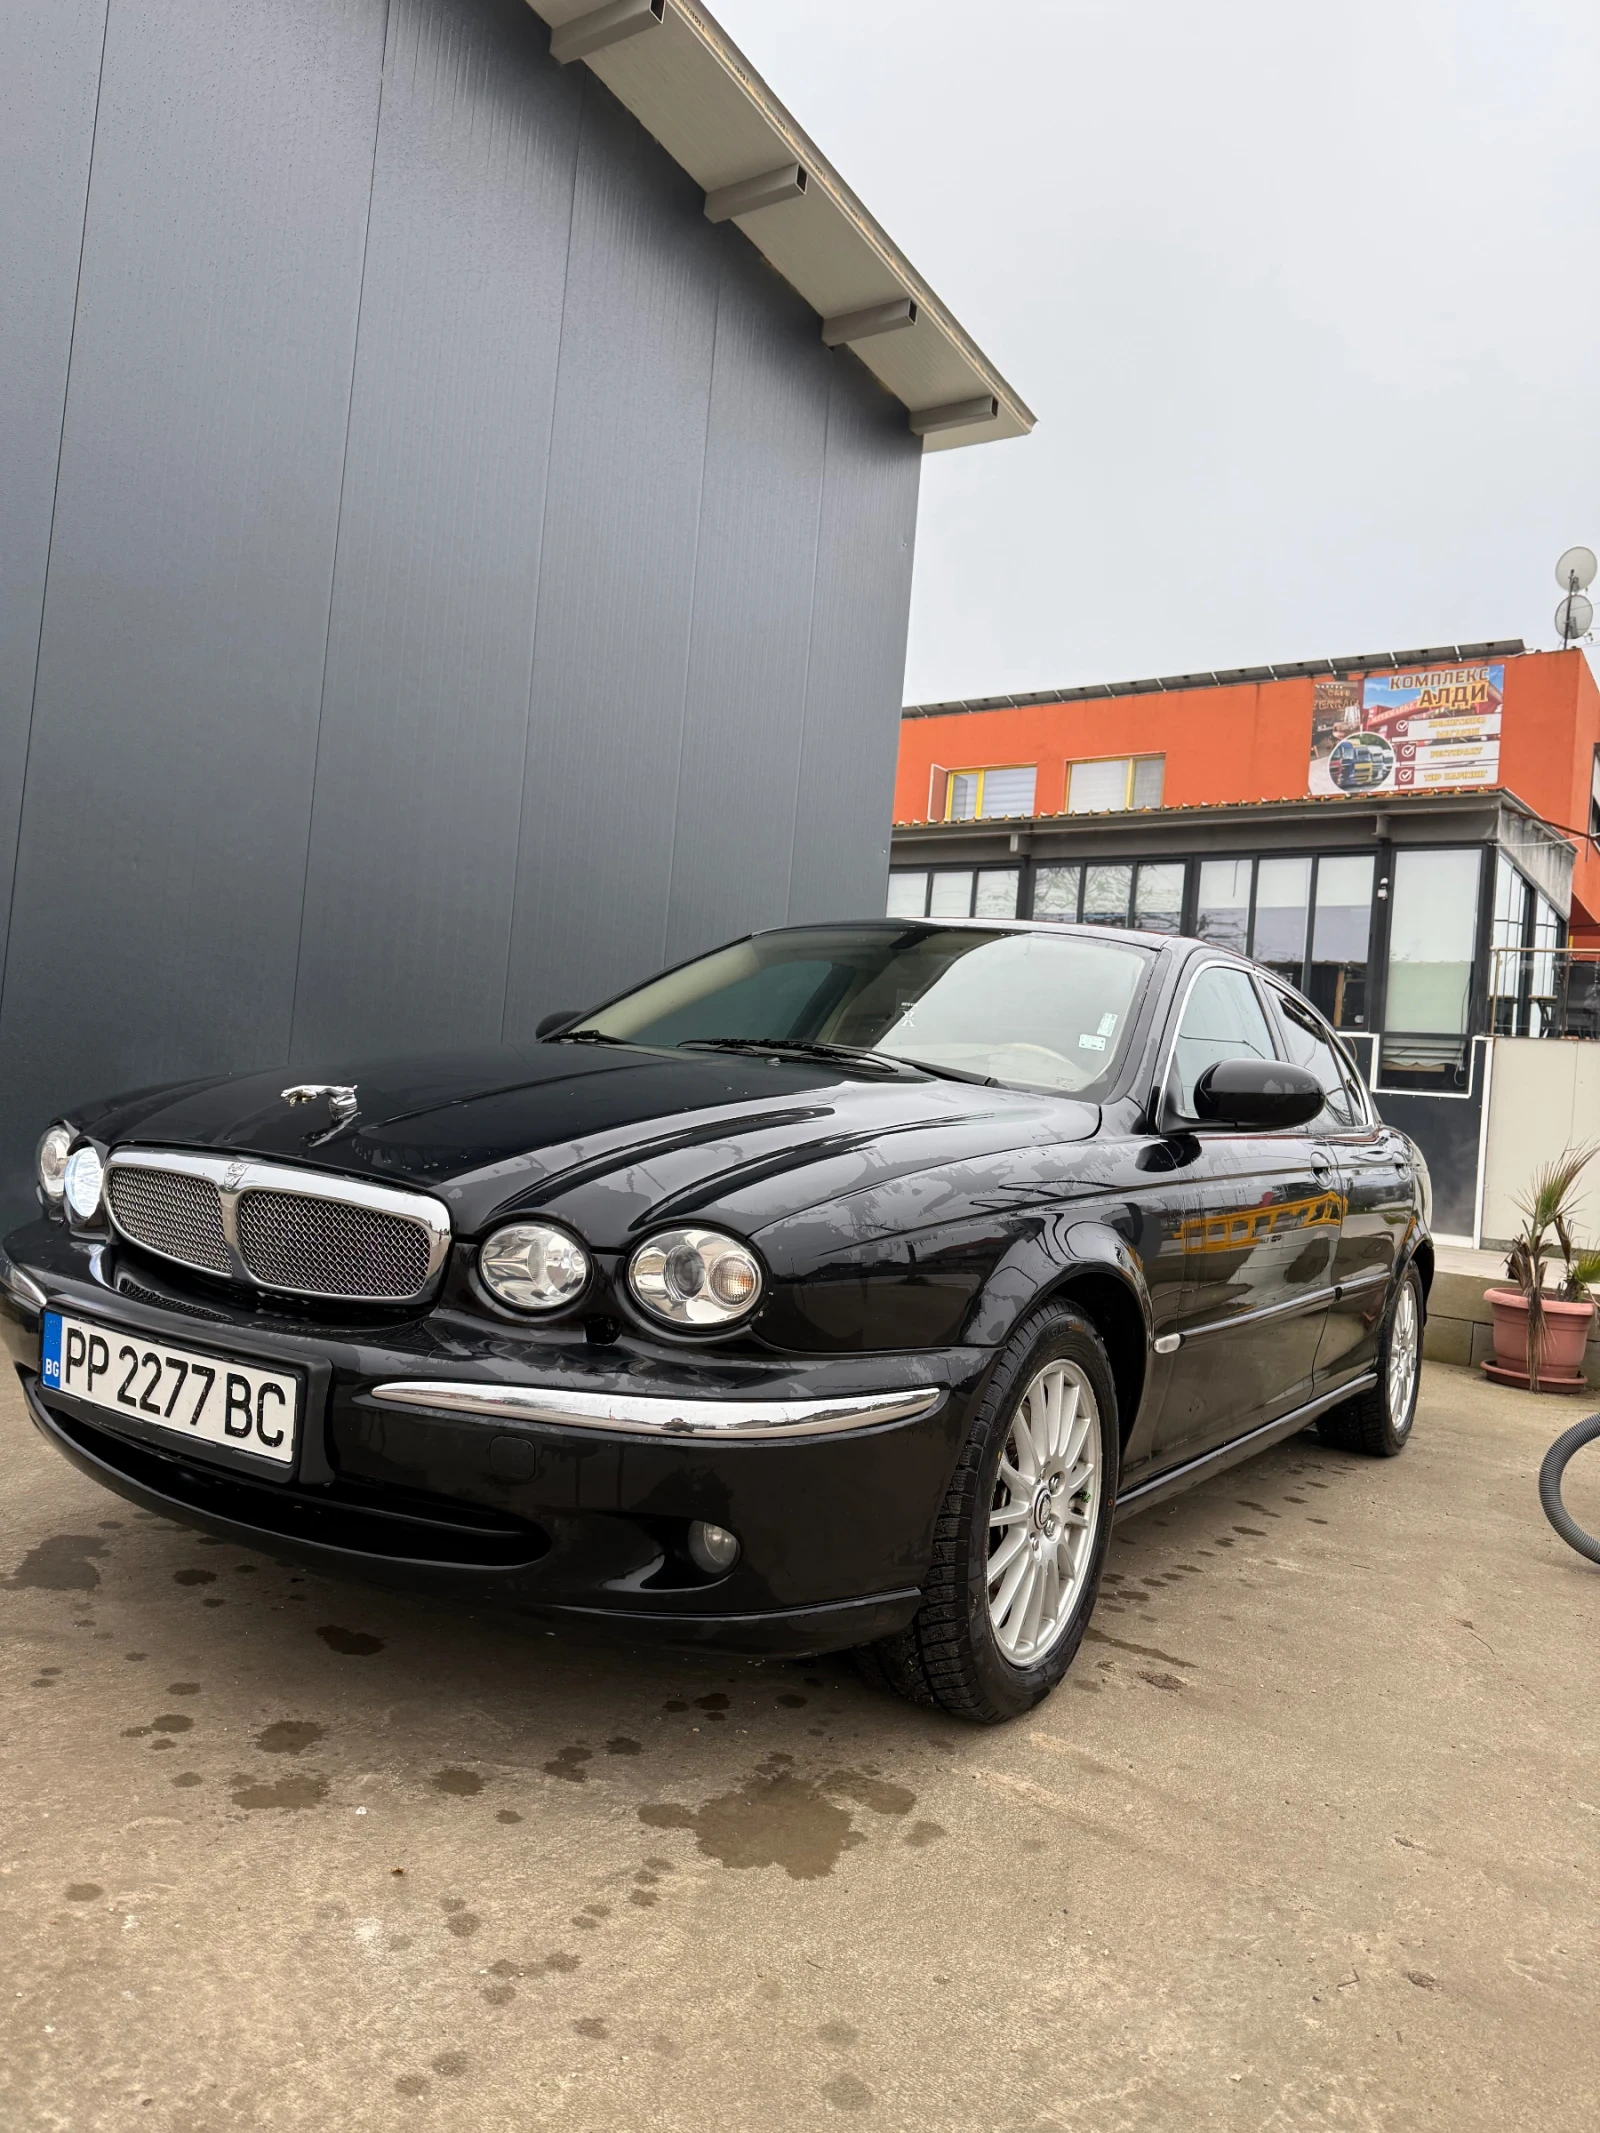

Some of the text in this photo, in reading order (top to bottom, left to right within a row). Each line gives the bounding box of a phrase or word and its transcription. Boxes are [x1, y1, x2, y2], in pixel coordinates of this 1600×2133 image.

[1390, 668, 1489, 690] КОМПЛЕКС
[1419, 683, 1487, 709] АЛДИ
[45, 1358, 59, 1378] BG
[65, 1327, 286, 1448] PP 2277 BC
